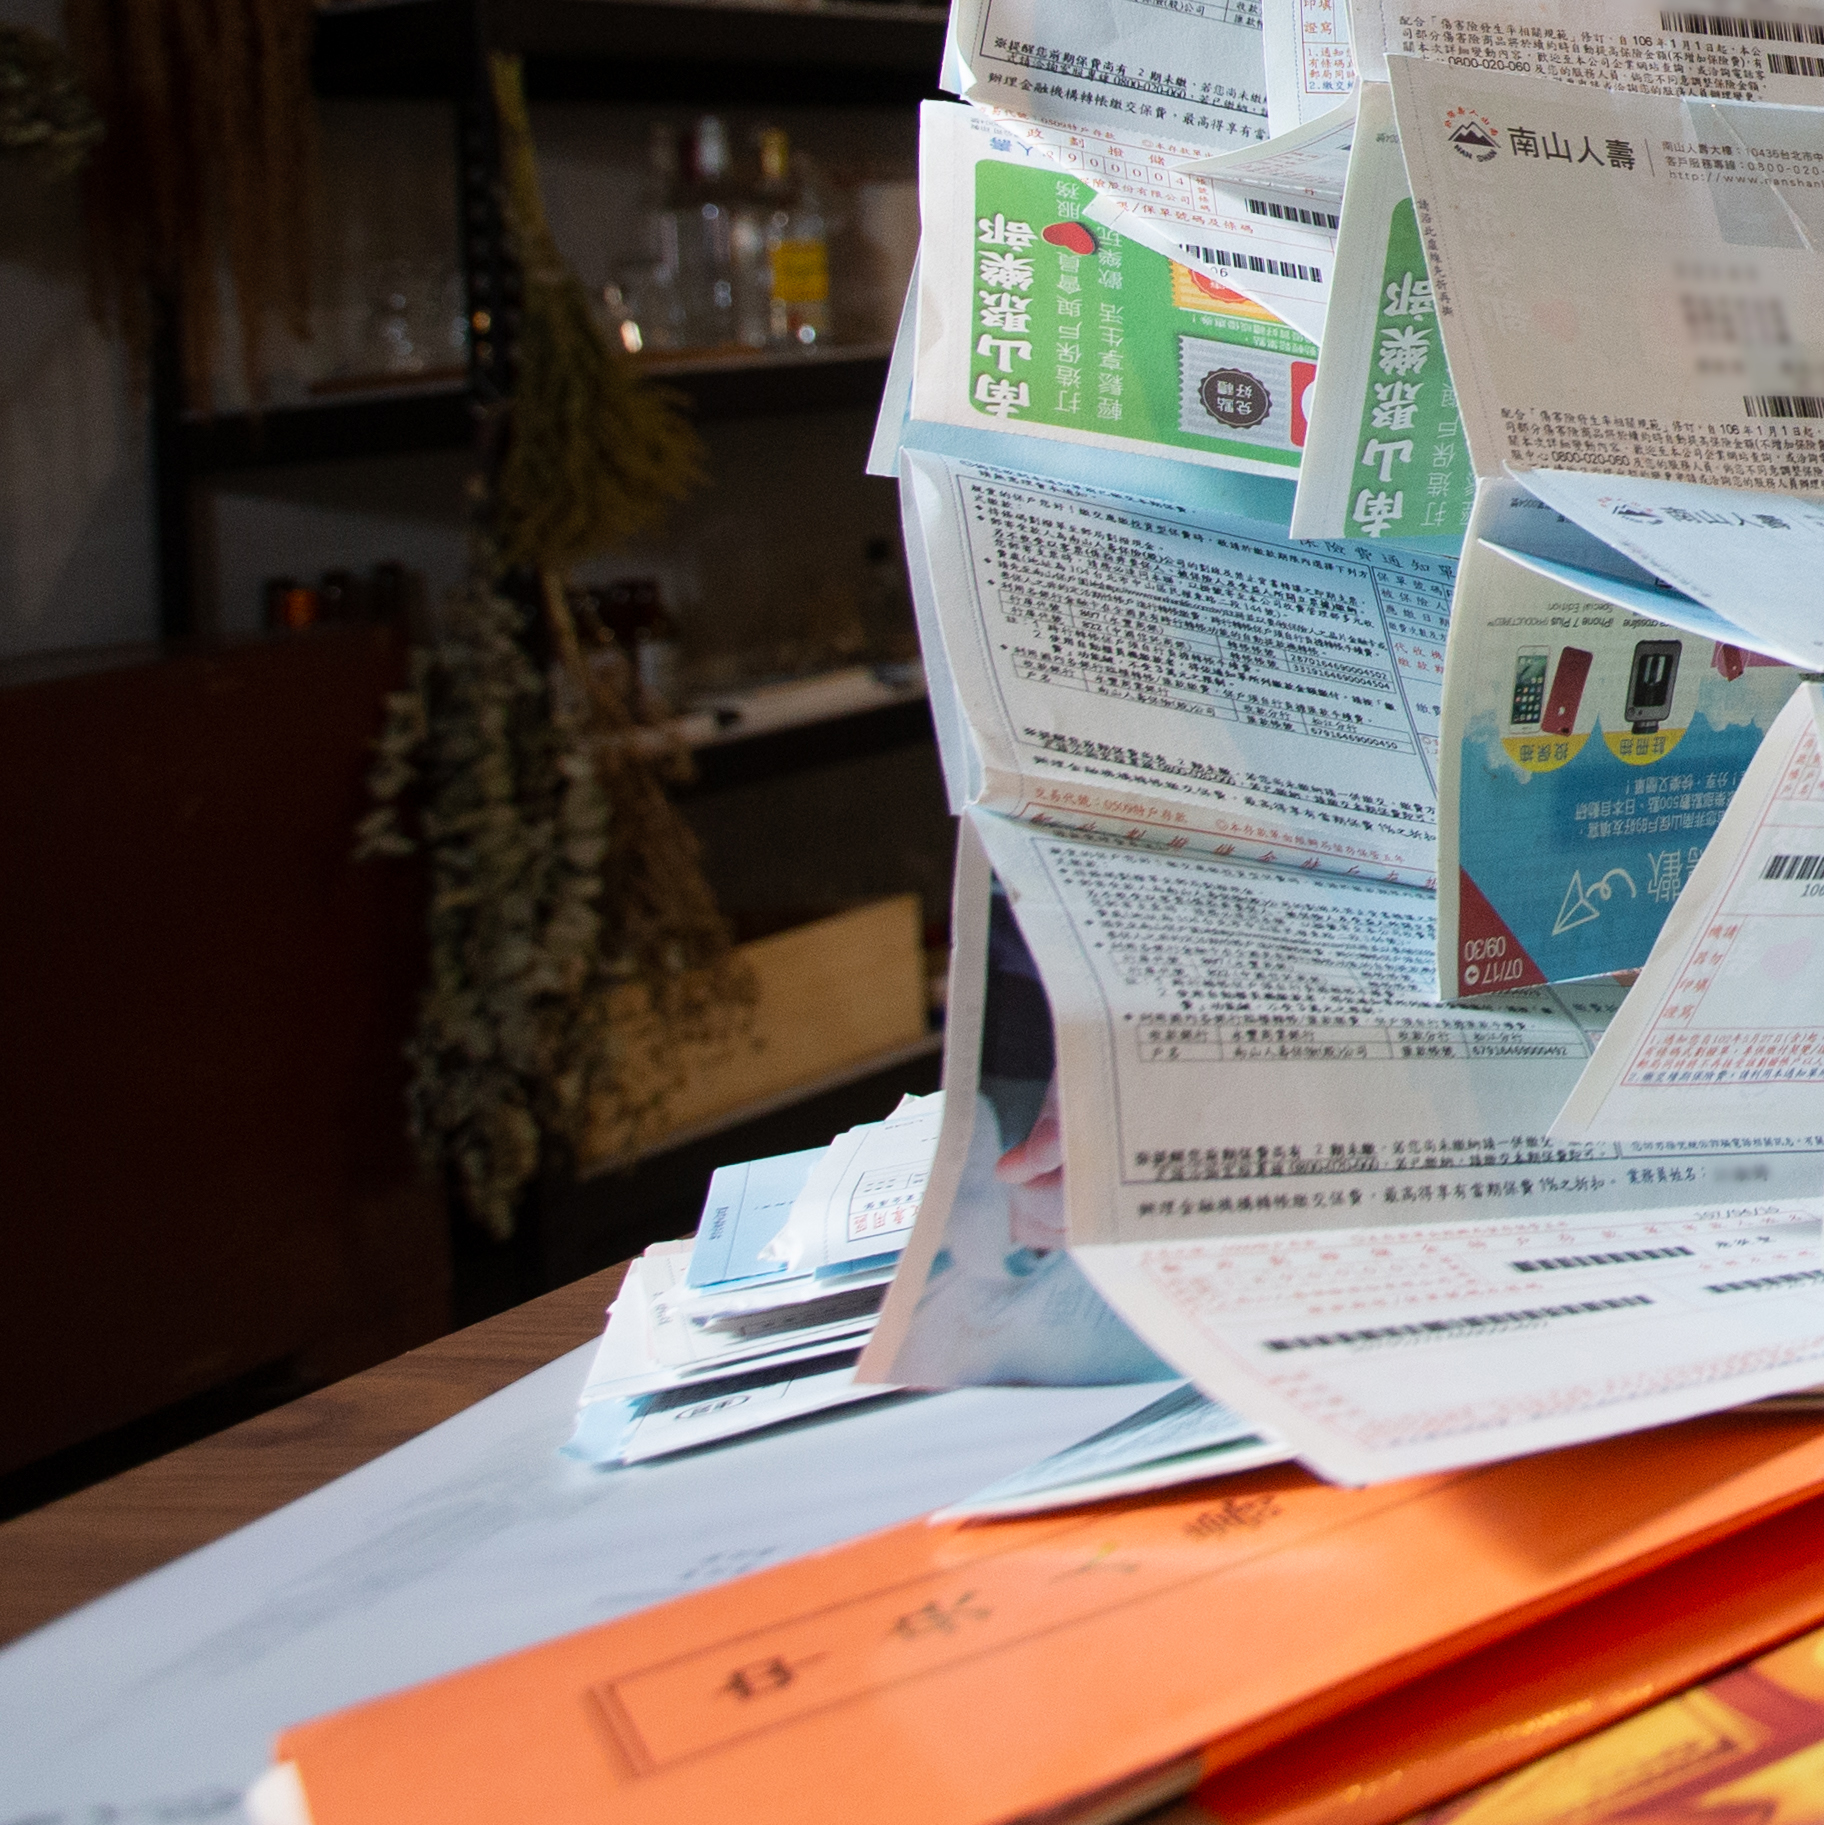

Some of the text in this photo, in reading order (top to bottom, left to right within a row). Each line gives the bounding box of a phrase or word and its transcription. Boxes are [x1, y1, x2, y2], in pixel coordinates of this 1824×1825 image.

[1633, 36, 1653, 46] 106
[1453, 144, 1473, 159] NAN
[1507, 126, 1636, 171] 南山人壽
[975, 213, 1039, 419] 南山聚樂部
[1352, 272, 1437, 536] 南山聚樂部
[1720, 424, 1740, 435] 106
[1551, 451, 1630, 466] 0800-020-060
[1377, 572, 1442, 596] 保單號碼
[1551, 616, 1572, 628] Plus
[1582, 616, 1615, 629] iPhone
[1519, 742, 1569, 764] 投保抽
[1619, 734, 1668, 756] 註冊抽
[1465, 936, 1507, 960] 09/30
[1482, 958, 1524, 983] 07/17
